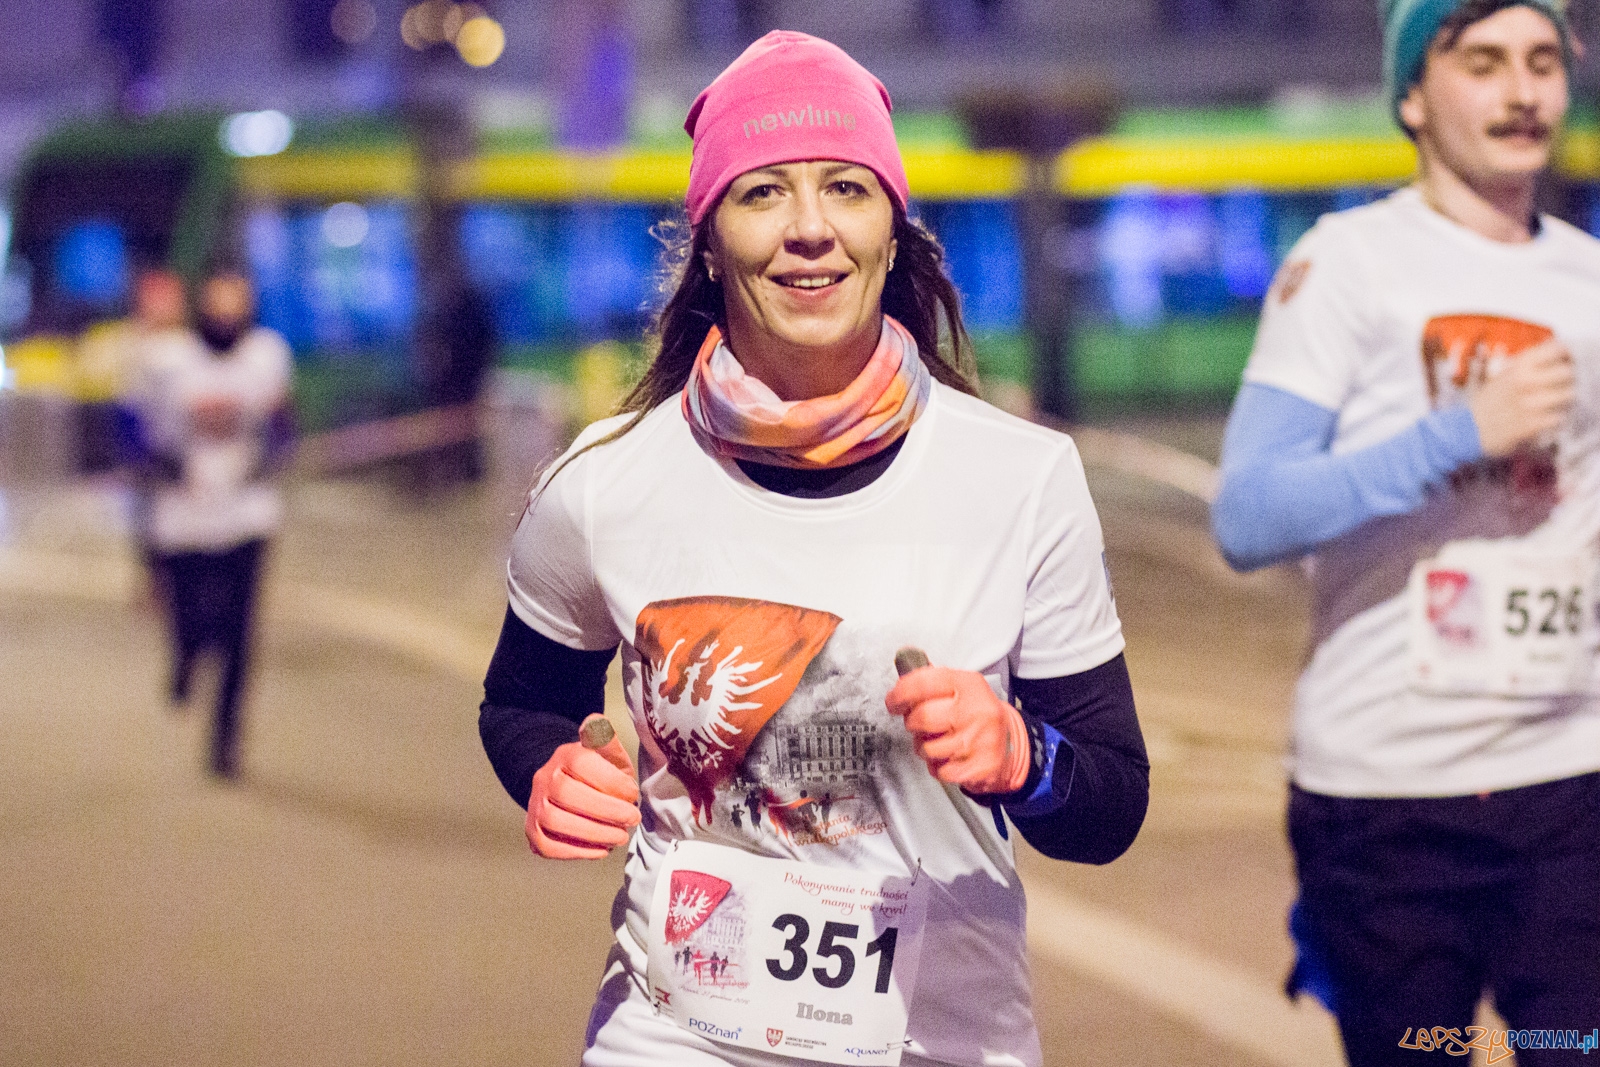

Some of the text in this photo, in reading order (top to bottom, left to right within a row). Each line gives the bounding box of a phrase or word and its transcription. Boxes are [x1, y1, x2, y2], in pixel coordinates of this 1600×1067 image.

[743, 104, 856, 138] newline
[783, 871, 909, 901] Pokonywanie trudności
[821, 897, 855, 916] mamy
[860, 903, 875, 913] we
[765, 913, 898, 994] 351
[796, 1002, 853, 1026] Ilona
